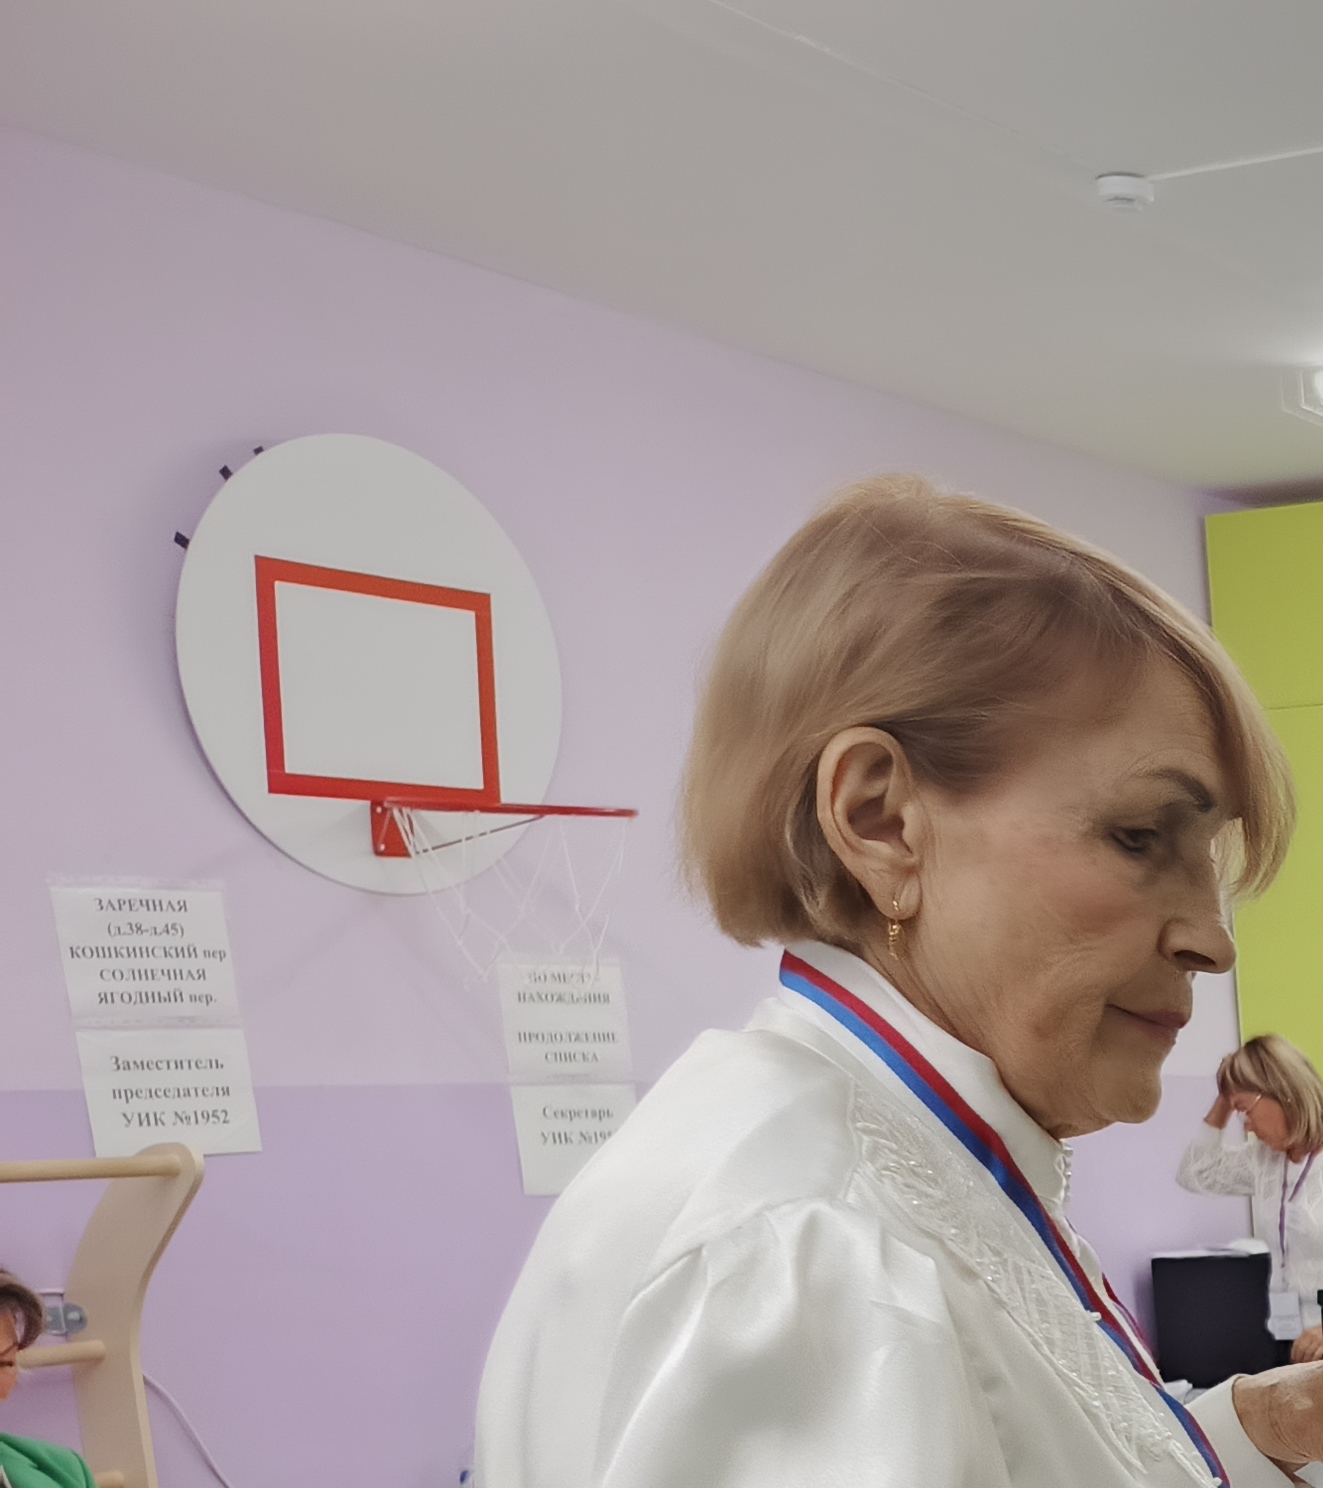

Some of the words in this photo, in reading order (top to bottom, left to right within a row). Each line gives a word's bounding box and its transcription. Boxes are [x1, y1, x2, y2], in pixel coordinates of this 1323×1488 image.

[94, 898, 188, 912] ЗАРЕЧНАЯ
[107, 921, 185, 938] (д.38-д.45)
[69, 943, 198, 960] КОШКИНСКИЙ
[203, 949, 227, 962] пер
[99, 968, 207, 982] СОЛНЕЧНАЯ
[98, 987, 184, 1006] ЯГОДНЫЙ
[518, 1030, 619, 1045] ПРОДОЛЖЕНИЕ
[110, 1055, 224, 1072] Заместитель
[544, 1050, 600, 1064] СПИСКА
[112, 1085, 230, 1104] председателя
[121, 1111, 166, 1129] УИК
[172, 1108, 230, 1127] №1952
[542, 1105, 613, 1122] Секретарь
[541, 1131, 574, 1146] УИК
